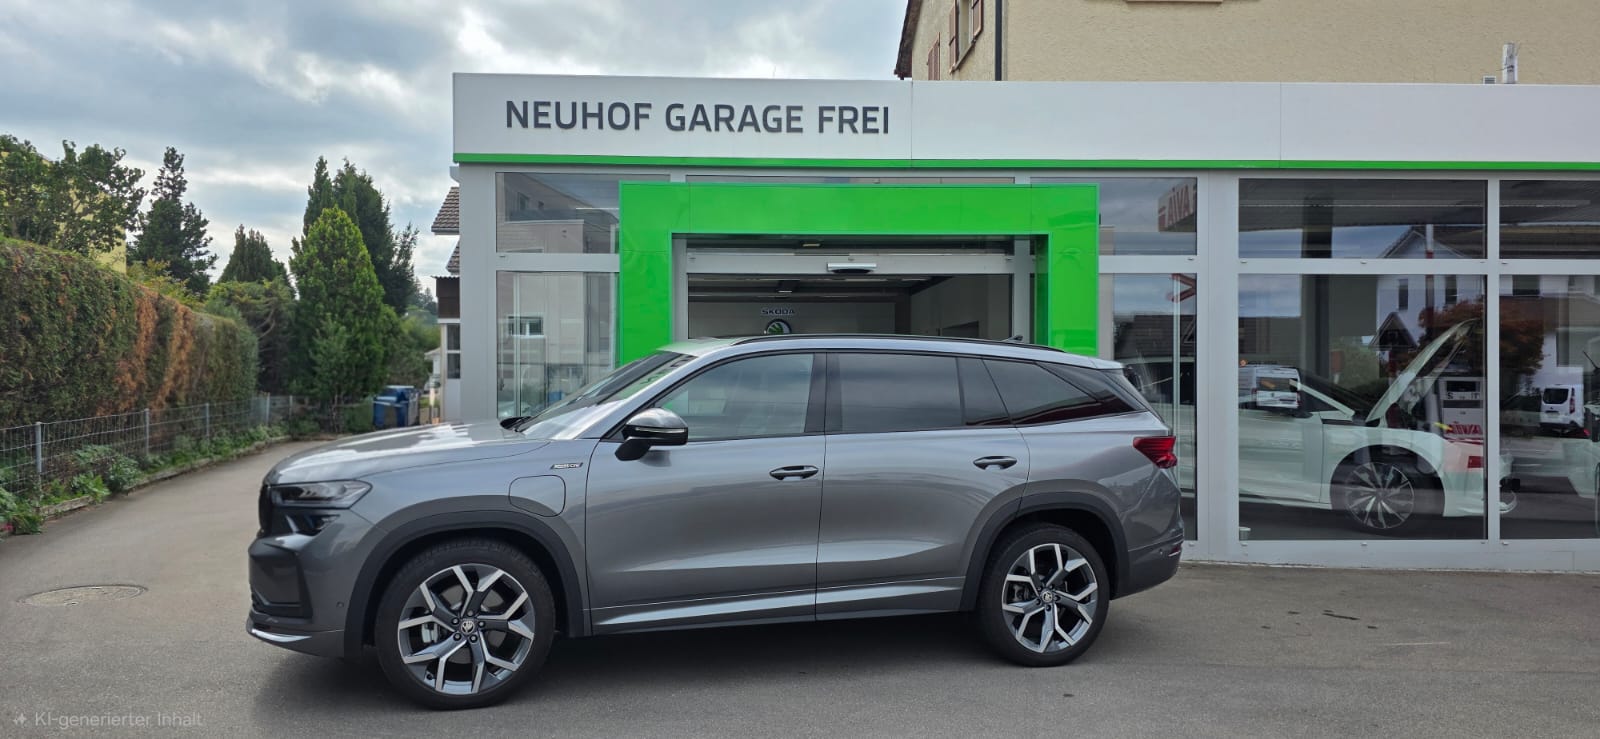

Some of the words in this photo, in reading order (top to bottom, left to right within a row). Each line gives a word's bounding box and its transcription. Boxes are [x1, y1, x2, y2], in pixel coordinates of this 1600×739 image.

[506, 100, 652, 131] NEUHOF
[665, 103, 804, 134] GARAGE
[818, 105, 889, 135] FREI
